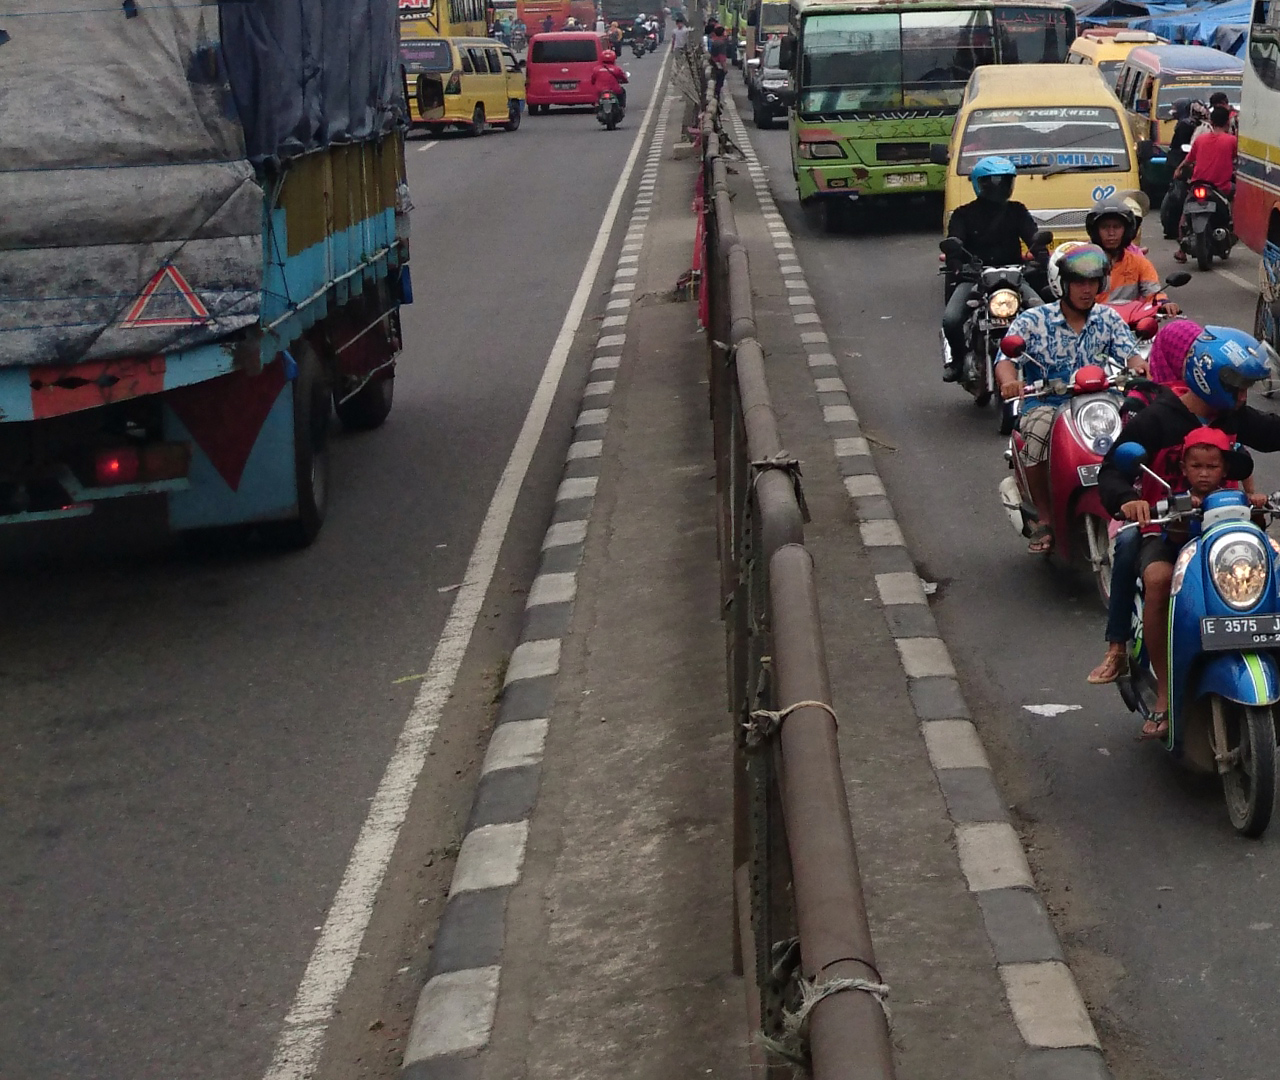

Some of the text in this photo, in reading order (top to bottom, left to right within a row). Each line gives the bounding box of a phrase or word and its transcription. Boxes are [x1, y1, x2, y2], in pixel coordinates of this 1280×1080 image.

[1056, 153, 1114, 166] MILAN
[1206, 621, 1215, 634] E
[1224, 620, 1257, 632] 3575
